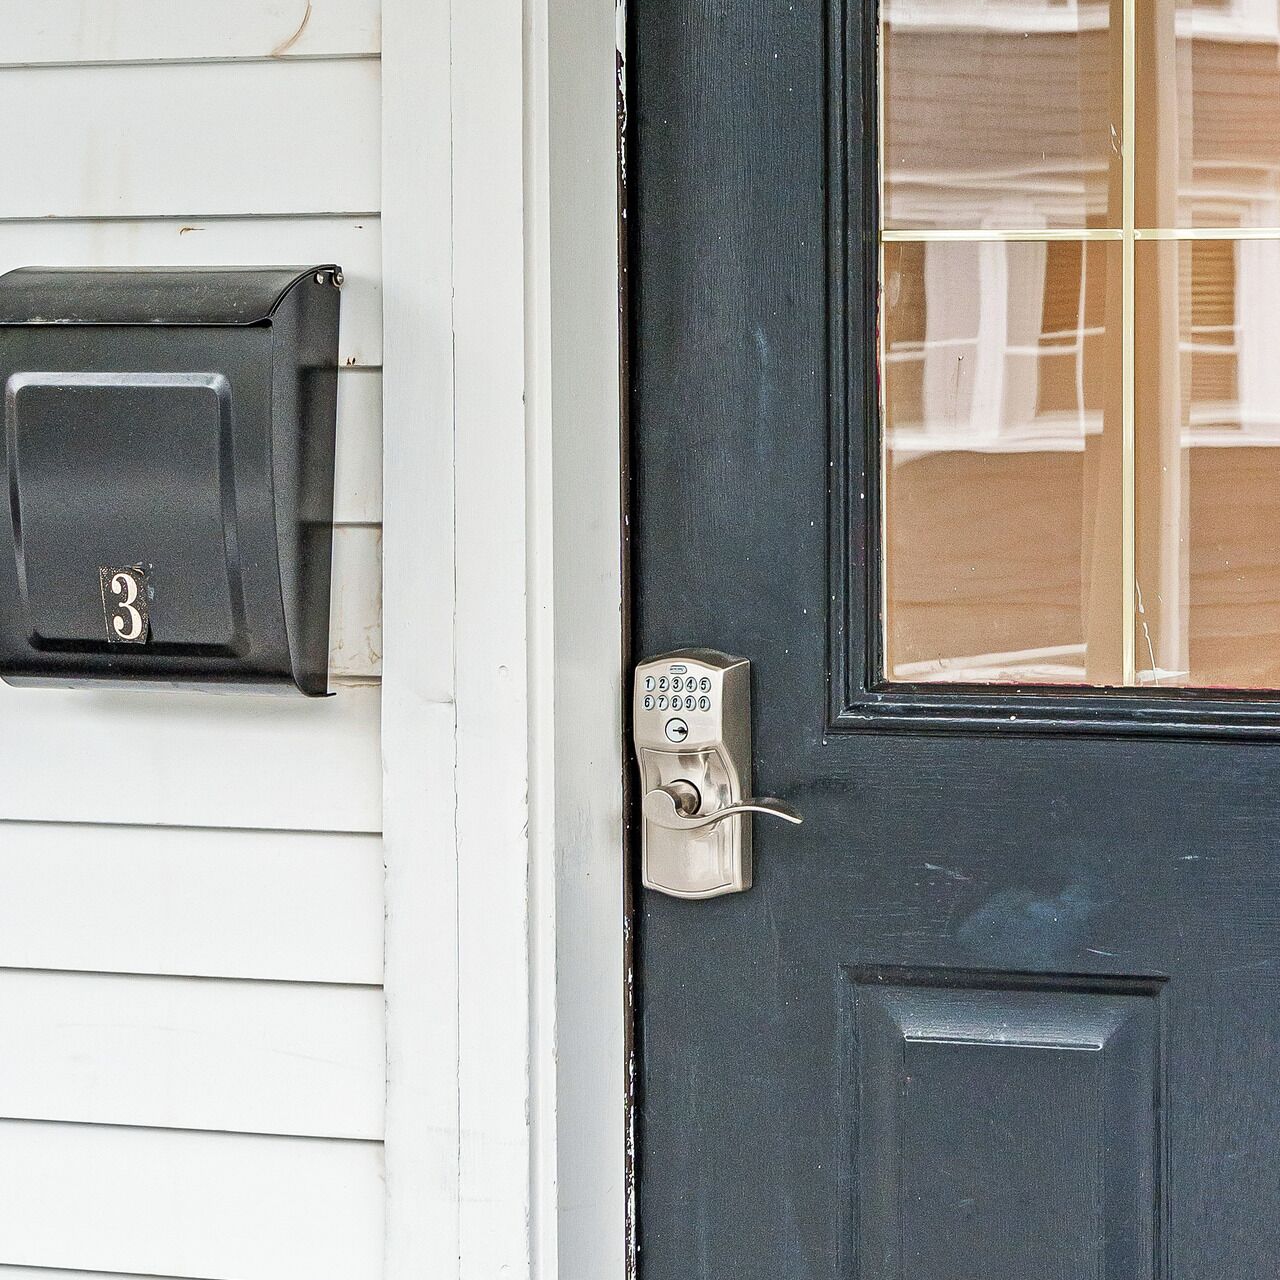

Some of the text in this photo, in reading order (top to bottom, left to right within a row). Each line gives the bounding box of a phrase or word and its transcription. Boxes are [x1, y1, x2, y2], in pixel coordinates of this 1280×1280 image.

[111, 573, 143, 640] 3
[645, 678, 707, 690] 1 2 3 4 5
[644, 697, 706, 709] 6 7 8 9 0
